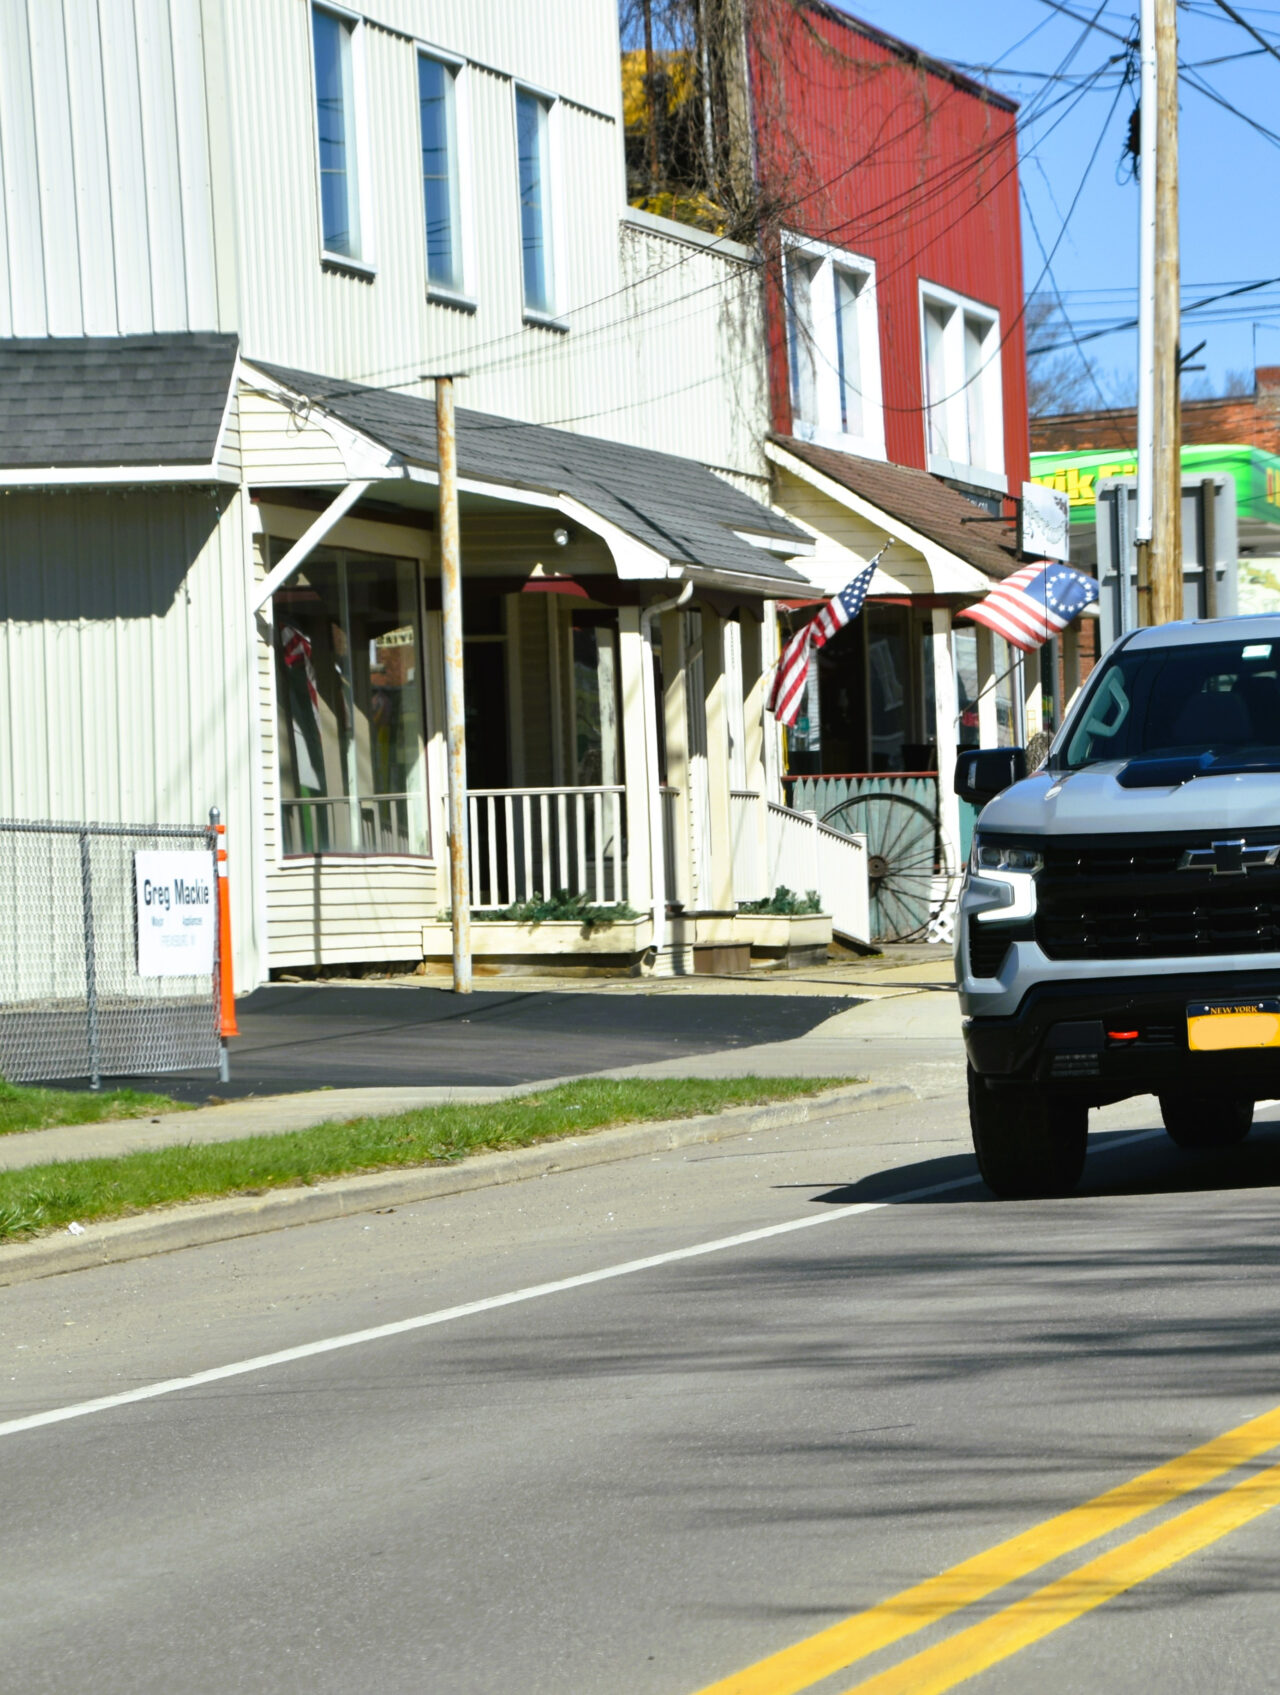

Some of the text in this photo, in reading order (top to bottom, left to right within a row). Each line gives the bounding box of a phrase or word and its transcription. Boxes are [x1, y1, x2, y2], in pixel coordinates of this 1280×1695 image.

[144, 878, 209, 911] Greg Mackie
[1210, 1005, 1258, 1015] NEW YORK
